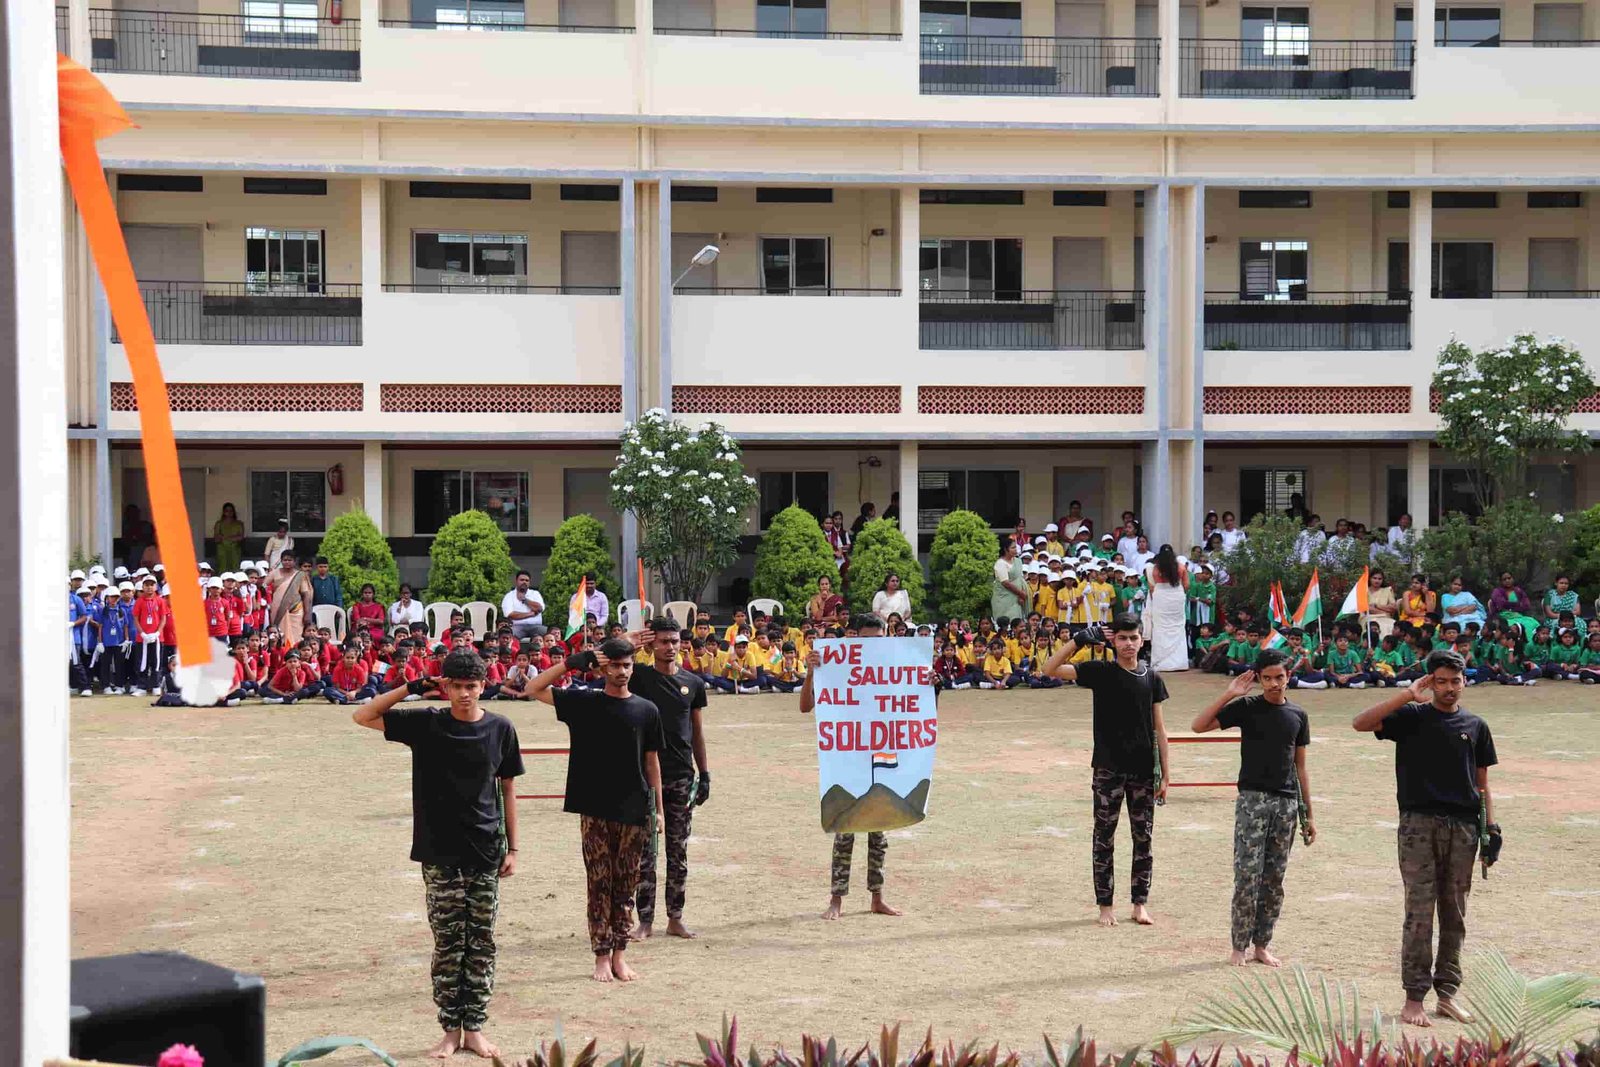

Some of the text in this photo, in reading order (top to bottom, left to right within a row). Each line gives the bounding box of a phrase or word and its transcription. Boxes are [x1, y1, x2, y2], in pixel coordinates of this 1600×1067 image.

[822, 643, 862, 664] WE
[847, 665, 930, 686] SALUTE
[817, 688, 919, 713] ALL THE
[818, 718, 937, 751] SOLDIERS
